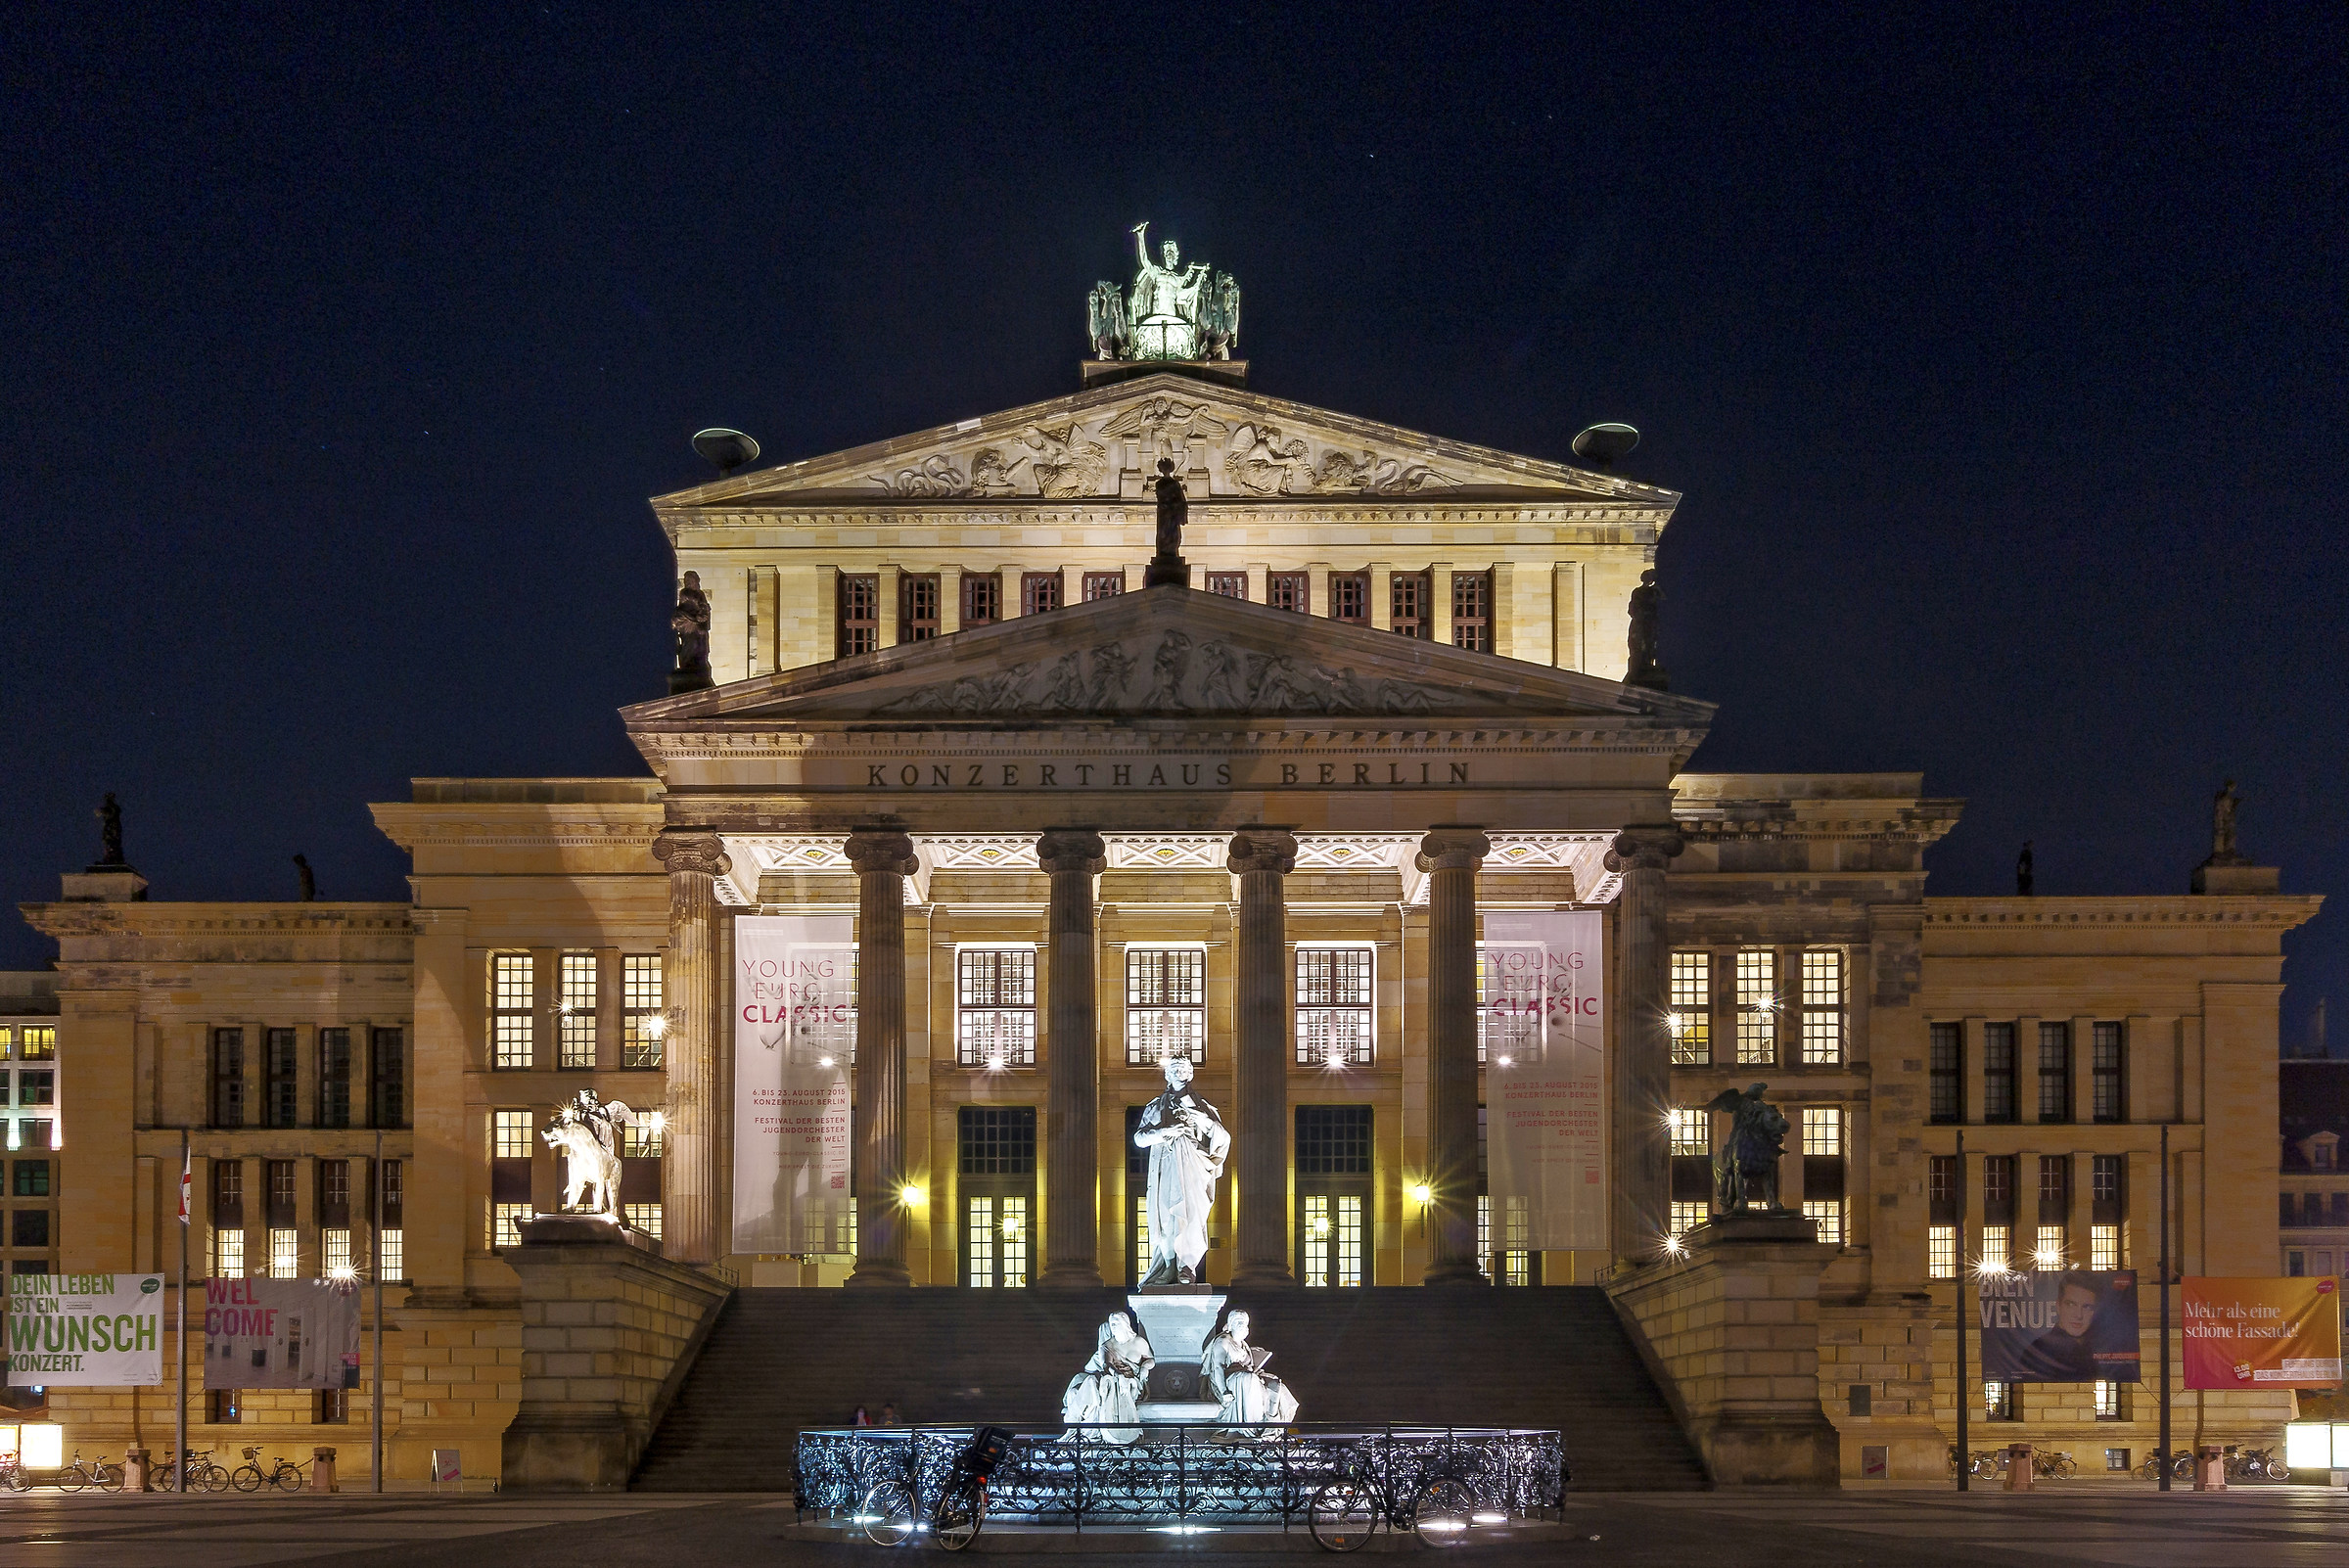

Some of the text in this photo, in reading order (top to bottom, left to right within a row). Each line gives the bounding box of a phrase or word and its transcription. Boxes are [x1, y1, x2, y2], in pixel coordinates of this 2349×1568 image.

[867, 762, 1469, 786] KONZERTHAUS BERLIN
[743, 959, 834, 978] YOUNG
[1491, 951, 1584, 970] YOUNG
[743, 1004, 848, 1023] CLASSIC
[1492, 996, 1597, 1016] CLASSIC
[1505, 1090, 1567, 1099] KONZERTHAUS
[762, 1126, 846, 1134] JUGENDORCHESTER
[10, 1273, 115, 1295] DEIN LEBEN
[206, 1276, 260, 1305] WEL
[1979, 1272, 2035, 1298] BIEN
[10, 1297, 33, 1314] IST
[36, 1297, 60, 1314] EIN
[1979, 1300, 2057, 1328] VENUE
[2185, 1301, 2280, 1318] Mehr als eine
[205, 1308, 279, 1337] COME
[2185, 1320, 2300, 1338] schöne Fassade!
[9, 1314, 157, 1353] WUNSCH
[8, 1354, 85, 1372] KONZERT.
